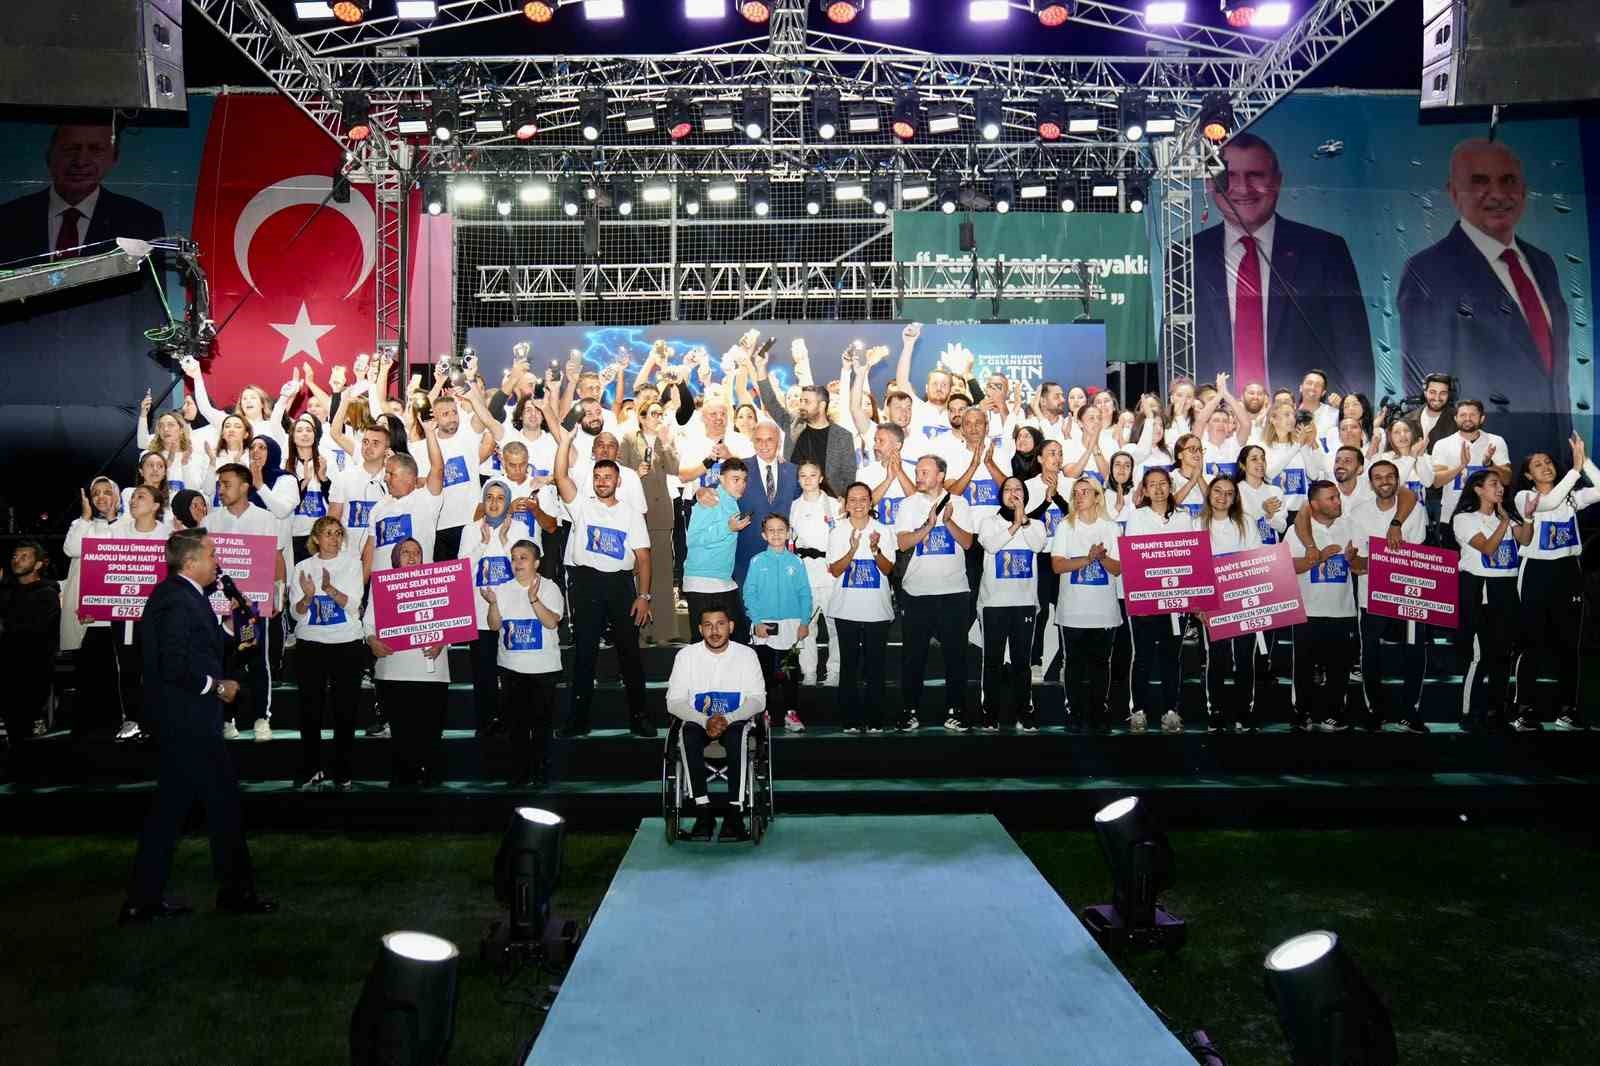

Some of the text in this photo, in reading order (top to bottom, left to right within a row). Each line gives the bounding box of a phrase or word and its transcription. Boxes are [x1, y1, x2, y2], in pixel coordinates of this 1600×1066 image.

[214, 537, 225, 545] CİP
[1131, 538, 1199, 550] ÜMRANİYE BELEDİYESİ
[97, 544, 166, 553] DUDULLU ÜMRANİYE
[222, 547, 251, 556] HAVUZU
[1141, 548, 1191, 559] PİLATES STÜDYO
[84, 553, 118, 561] ANADOLU
[118, 553, 137, 561] İMAM
[138, 554, 158, 562] HATİP
[1411, 550, 1443, 563] ÜMRANİYE
[127, 564, 156, 572] SALONU
[1214, 562, 1239, 574] RANİYE
[1371, 552, 1390, 563] BİROL
[1410, 559, 1431, 570] YÜZME
[1431, 564, 1455, 574] HAVUZU
[378, 563, 463, 583] TRABZON MİLLET BAHÇESİ
[1146, 567, 1191, 577] PERSONEL SAYISI
[1218, 565, 1270, 583] PİLATES STÜDYO
[387, 574, 456, 592] YAVUZ SELİM TUNCER
[1167, 577, 1174, 587] 6
[1391, 574, 1418, 585] PERSONEL
[124, 585, 137, 594] 26
[396, 585, 448, 600] SPOR TESİSLERİ
[1130, 587, 1213, 600] HİZMET VERİLEN SPORCU SAYISI
[1225, 590, 1253, 600] PERSONEL
[1407, 587, 1419, 596] 24
[399, 598, 448, 611] PERSONEL SAYISI
[1164, 598, 1183, 609] 1652
[1247, 597, 1254, 607] 6
[117, 607, 140, 616] 6745
[418, 611, 430, 620] 14
[1231, 610, 1256, 621] VERİLEN
[1256, 605, 1279, 615] SPORCU
[1401, 606, 1425, 618] 11856
[381, 617, 471, 637] HİZMET VERİLEN SPORCU SAYISI
[1246, 617, 1267, 629] 1652
[414, 631, 440, 643] 13750
